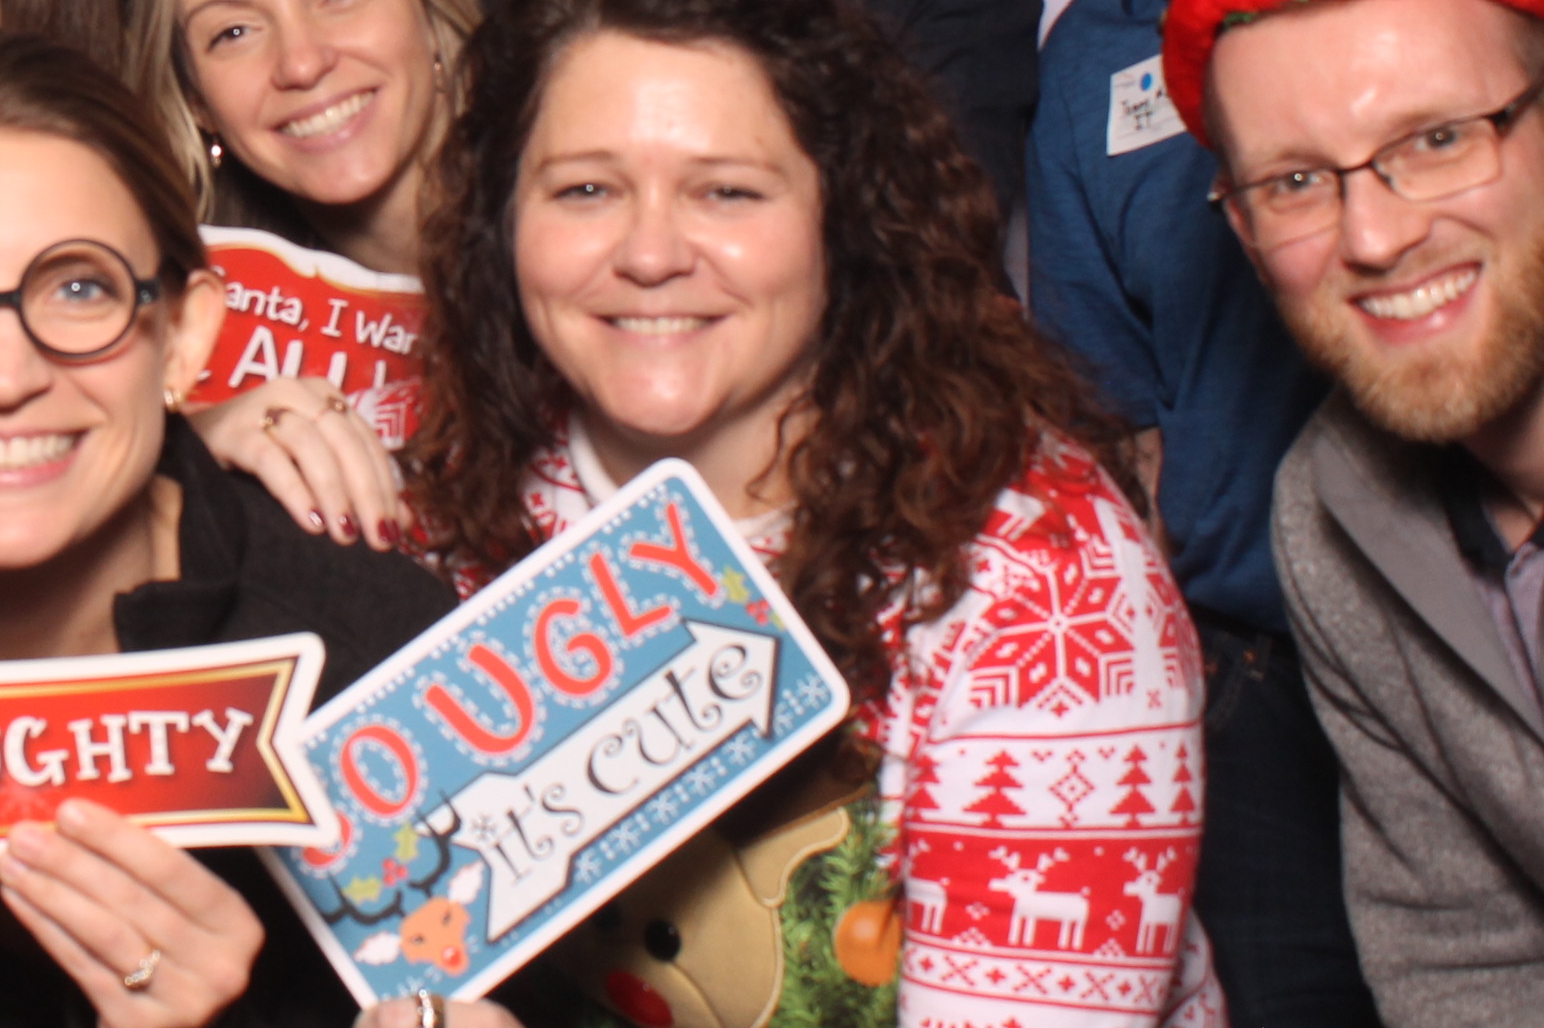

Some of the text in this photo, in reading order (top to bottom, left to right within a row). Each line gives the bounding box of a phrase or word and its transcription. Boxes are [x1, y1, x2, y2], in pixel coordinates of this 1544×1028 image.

[213, 267, 309, 333] anta,
[321, 299, 350, 338] I
[424, 501, 720, 755] UGLY
[586, 643, 762, 796] cute
